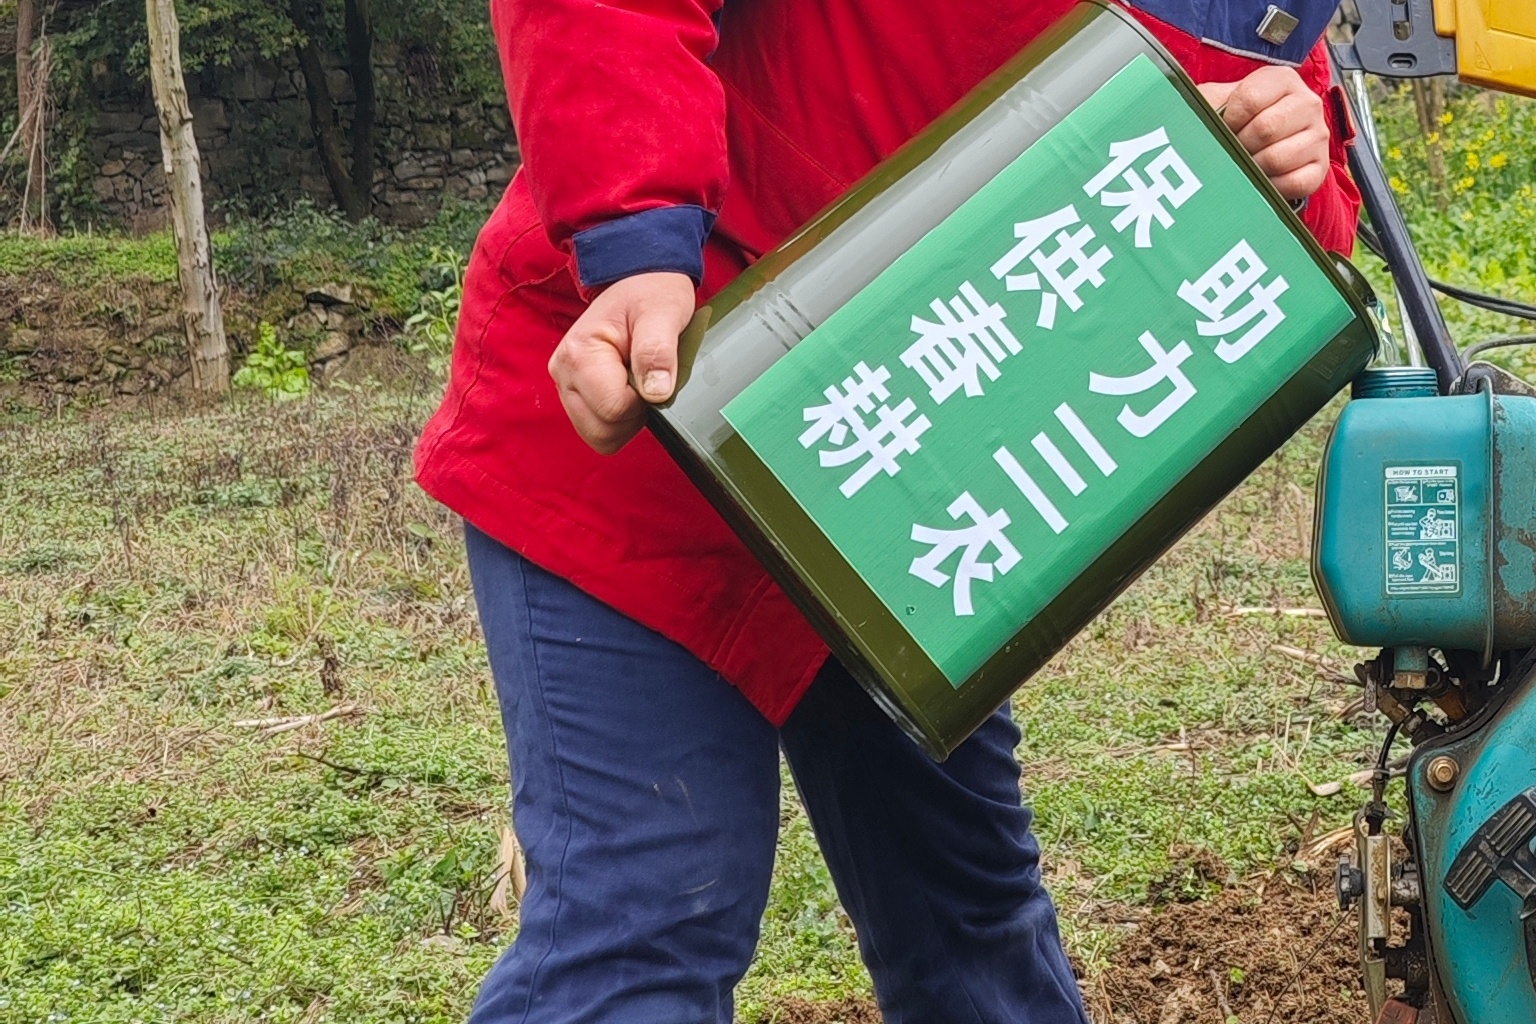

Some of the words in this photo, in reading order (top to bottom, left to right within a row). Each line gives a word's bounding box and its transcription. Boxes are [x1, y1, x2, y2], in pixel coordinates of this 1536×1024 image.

[799, 127, 1203, 497] 保供春耕
[910, 240, 1289, 615] 助力三农
